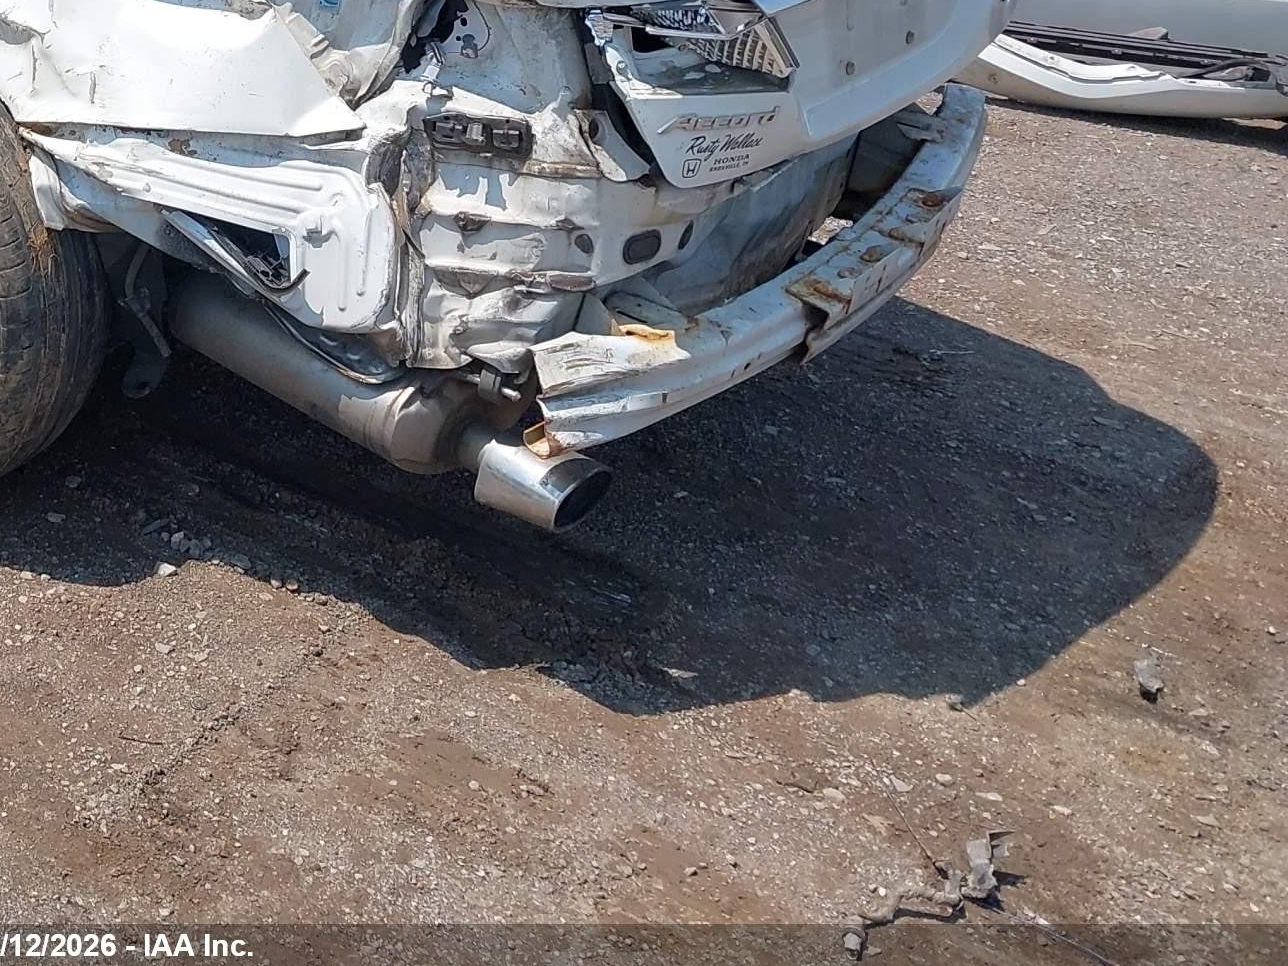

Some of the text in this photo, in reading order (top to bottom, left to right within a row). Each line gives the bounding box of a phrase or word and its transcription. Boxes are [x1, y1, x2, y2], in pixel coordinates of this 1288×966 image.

[657, 105, 781, 134] Accord
[686, 133, 764, 162] Rusty Wallace
[713, 154, 750, 165] HONDA
